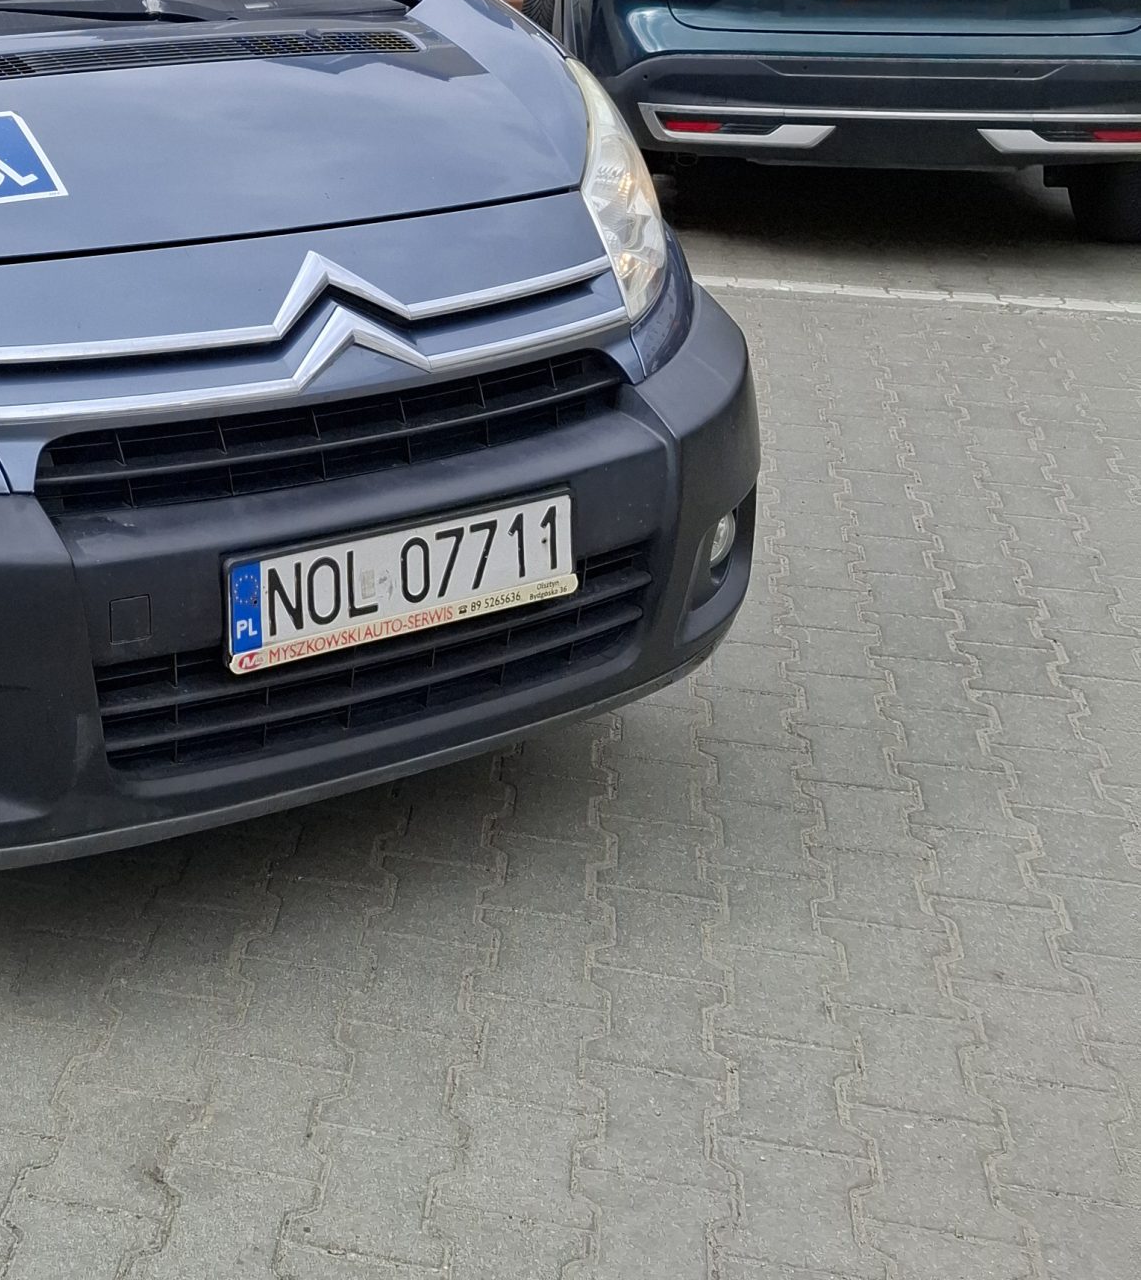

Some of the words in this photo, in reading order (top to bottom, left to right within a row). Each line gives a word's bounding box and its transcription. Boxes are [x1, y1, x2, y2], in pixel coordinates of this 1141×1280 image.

[267, 549, 379, 637] NOL
[400, 505, 558, 604] 07711
[536, 580, 560, 591] Olsztyn
[559, 586, 568, 594] 36
[236, 618, 258, 639] PL
[268, 628, 361, 663] MYSZKOWSKI
[363, 605, 454, 641] AUTO-SERWIS
[470, 600, 482, 612] 89
[484, 591, 521, 609] 5265636
